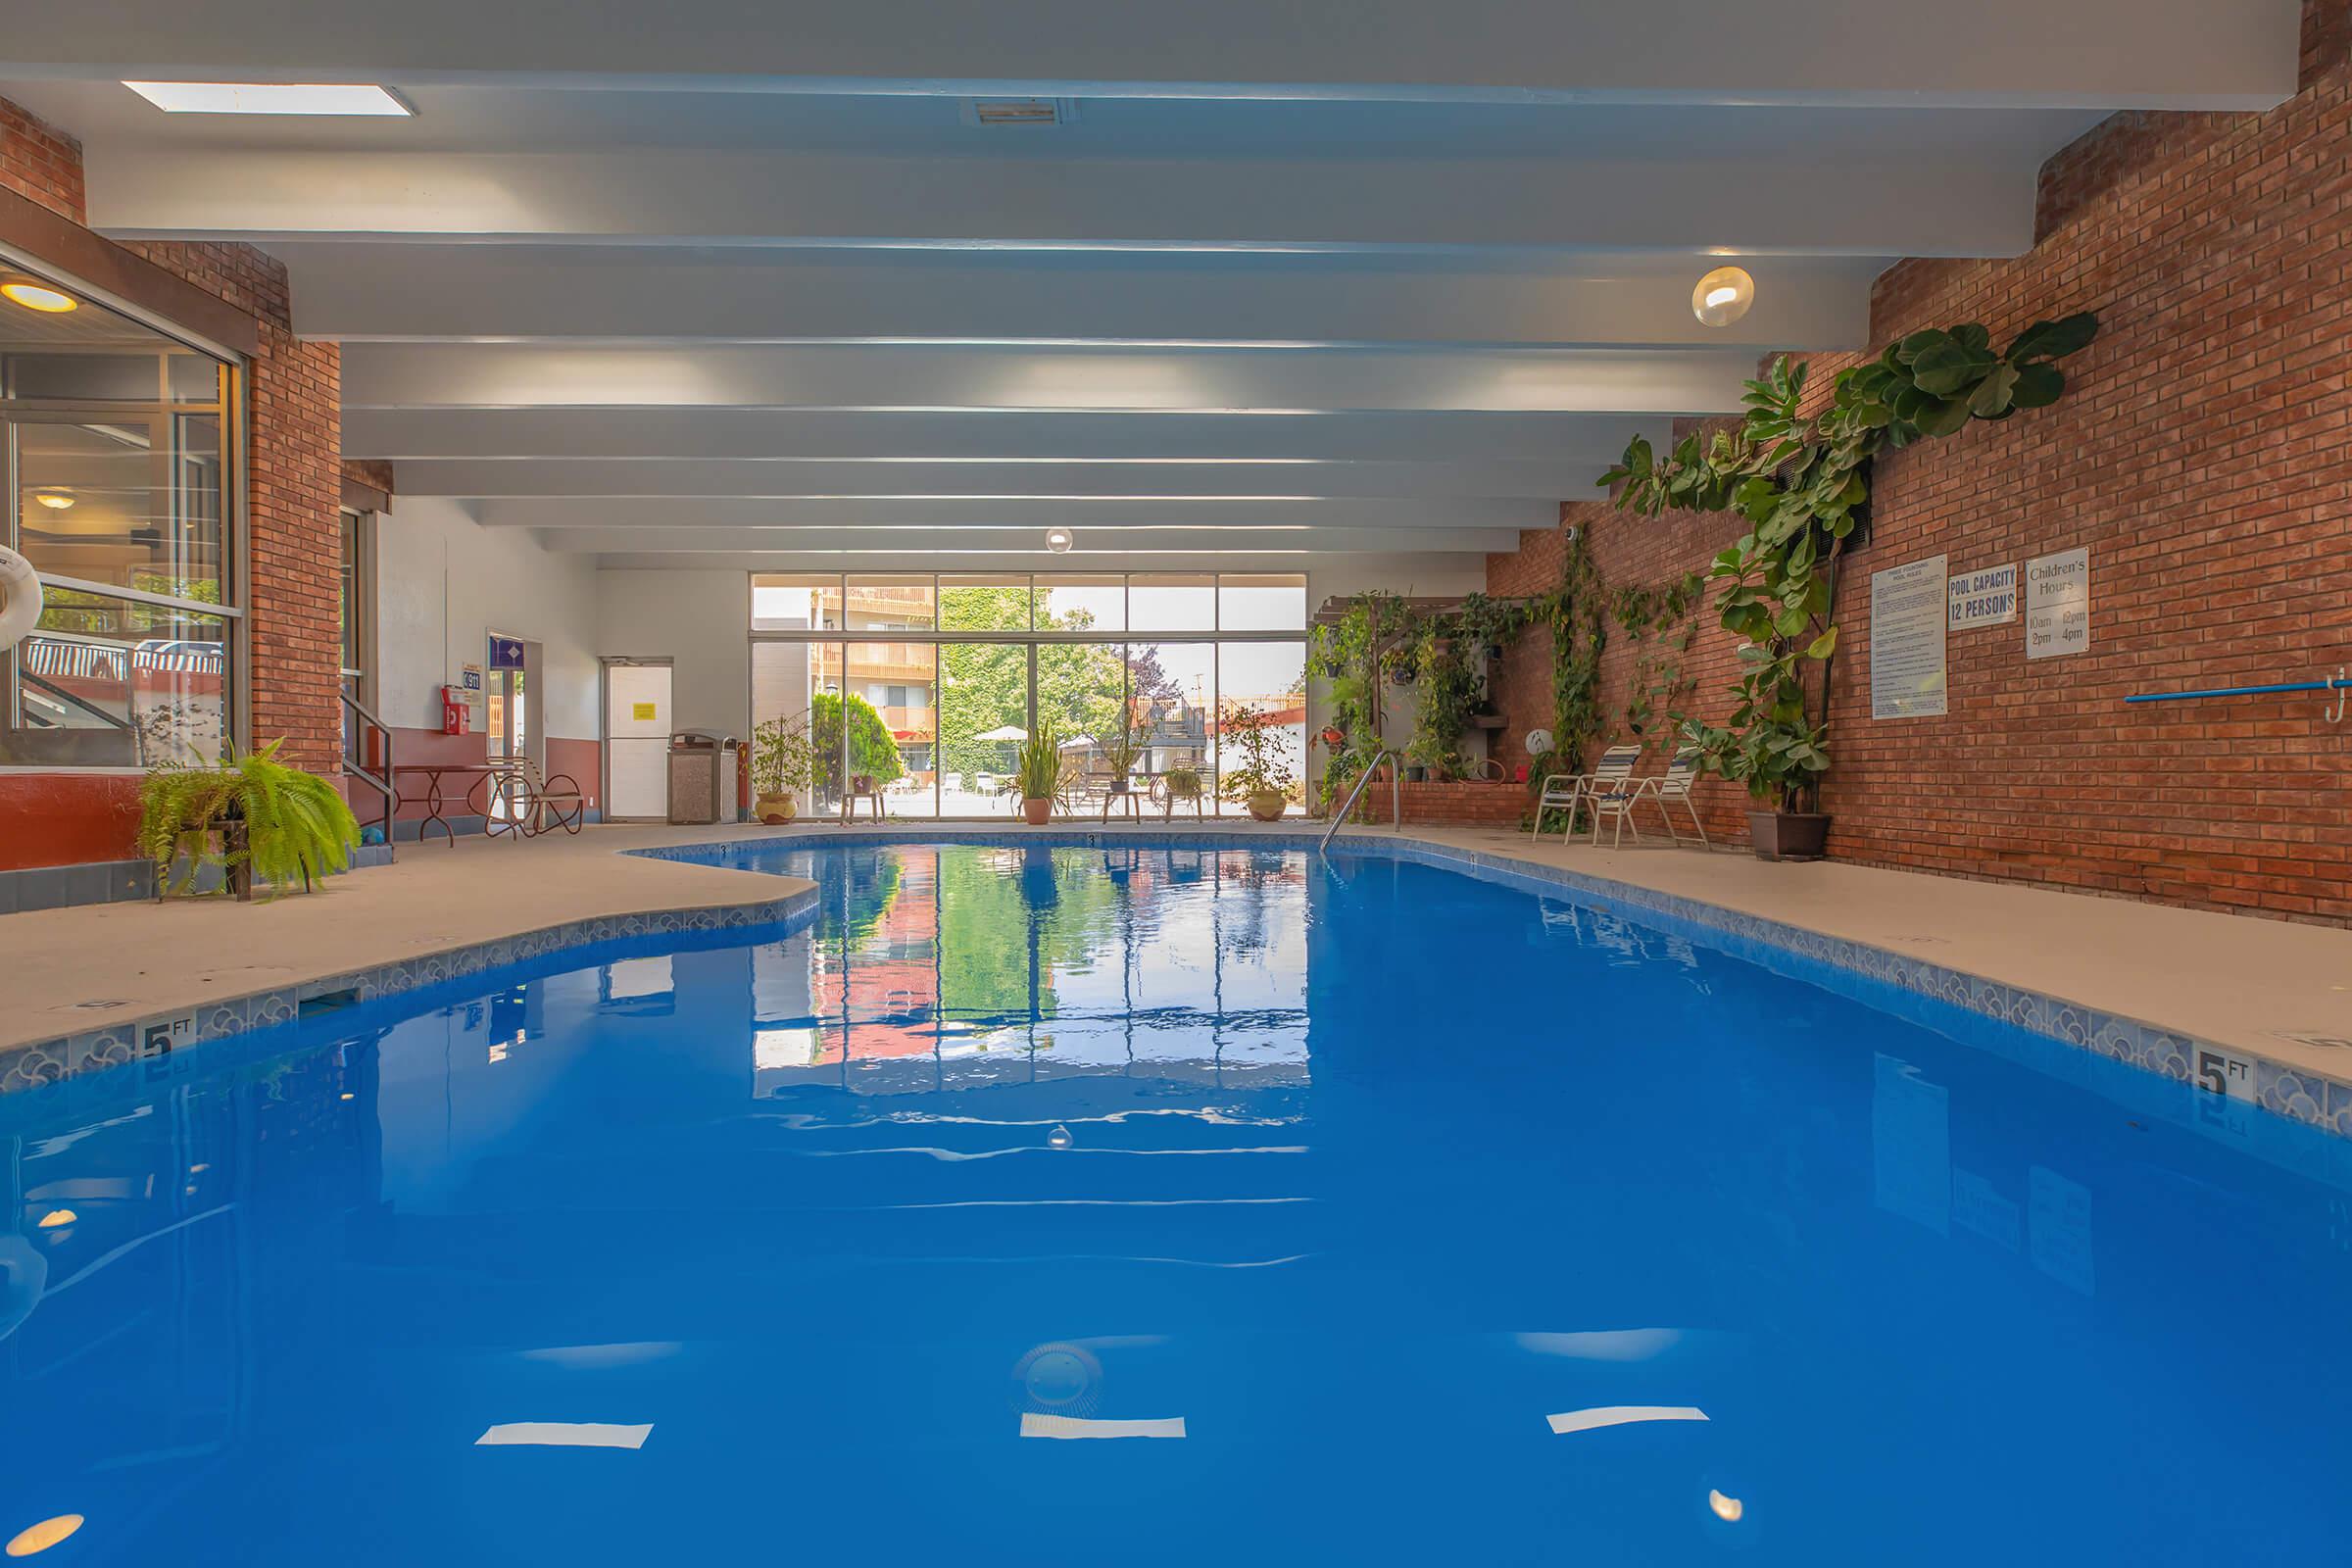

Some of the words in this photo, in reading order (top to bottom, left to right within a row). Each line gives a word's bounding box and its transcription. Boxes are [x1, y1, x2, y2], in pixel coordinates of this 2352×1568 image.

[2031, 561, 2085, 580] Children's
[1950, 579, 1970, 597] POOL
[1973, 568, 2016, 592] CAPACITY
[2039, 580, 2075, 596] Hours
[1951, 603, 1962, 621] 12
[1965, 593, 2015, 618] PERSONS
[2030, 616, 2052, 629] 10am
[2062, 611, 2086, 624] 12pm
[2032, 632, 2051, 646] 2pm
[2061, 627, 2083, 643] 4pm
[468, 673, 479, 688] 911
[144, 1024, 172, 1057] 5
[173, 1018, 191, 1035] FT
[2198, 1052, 2227, 1095] 5
[2230, 1060, 2248, 1080] FT
